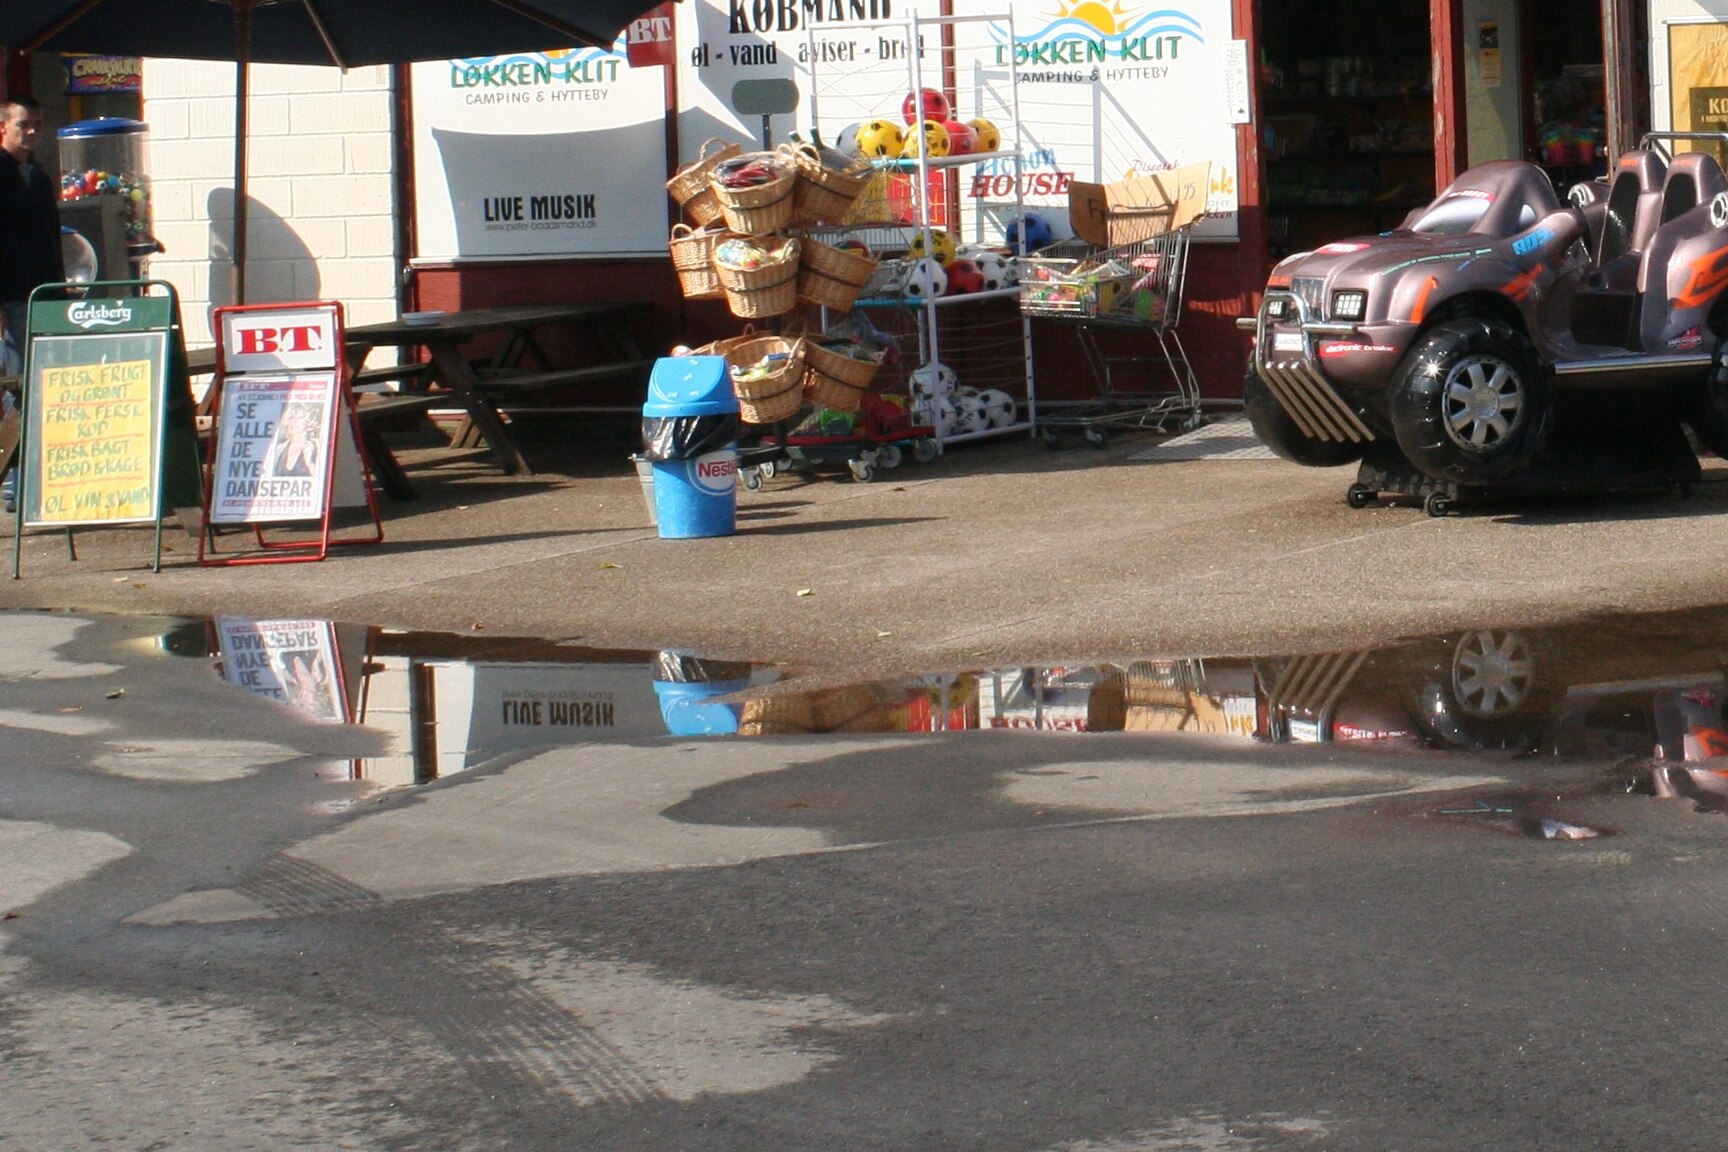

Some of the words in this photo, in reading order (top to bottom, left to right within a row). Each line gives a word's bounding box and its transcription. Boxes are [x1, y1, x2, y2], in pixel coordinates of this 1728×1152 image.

[730, 41, 777, 66] vand
[995, 38, 1106, 67] LØKKEN
[1120, 36, 1182, 61] KLIT
[451, 61, 551, 88] LØKKEN
[565, 59, 621, 84] KLIT
[1015, 70, 1084, 84] CAMPING
[1089, 68, 1100, 82] &
[1106, 66, 1169, 80] HYTTEBY
[465, 91, 531, 105] CAMPING
[536, 91, 545, 102] &
[551, 89, 609, 103] HYTTEBY
[967, 172, 1075, 198] HOUSE
[483, 196, 524, 222] LIVE
[530, 194, 596, 220] MUSIK
[68, 300, 133, 324] Carlsberg
[236, 325, 323, 355] B.T.
[48, 369, 95, 388] FRISK
[100, 363, 149, 383] FRUGT
[46, 406, 90, 423] FRISK
[236, 402, 258, 420] SE
[232, 421, 275, 439] ALLE
[46, 445, 90, 463] FRISK
[230, 441, 253, 458] DE
[105, 455, 145, 475] KAGE
[228, 460, 263, 478] NYE
[226, 480, 313, 498] DANSEPAR
[73, 490, 103, 510] VIN
